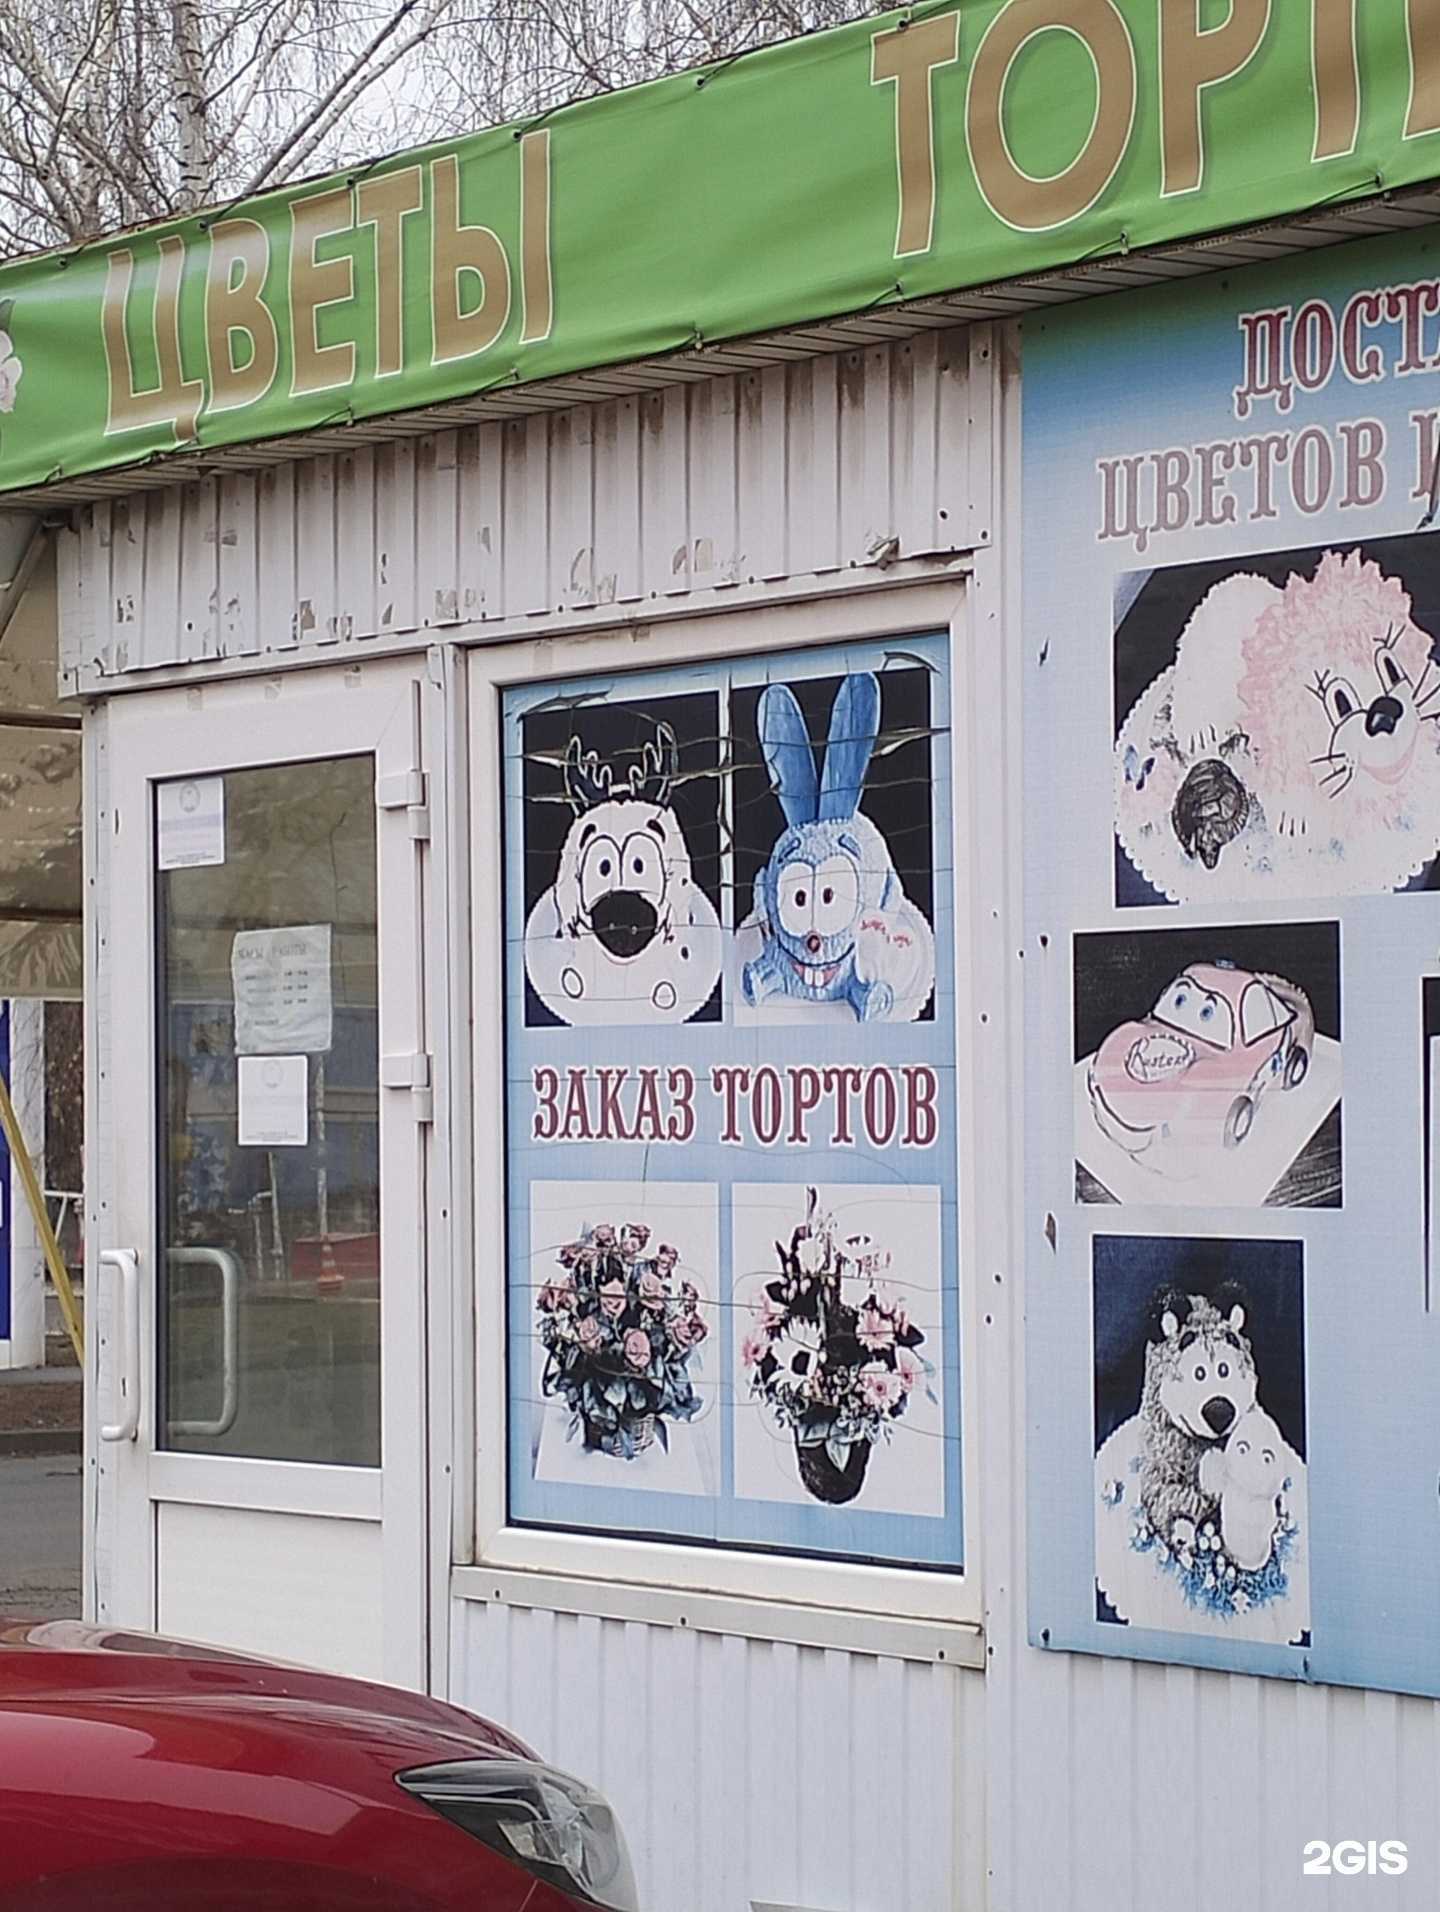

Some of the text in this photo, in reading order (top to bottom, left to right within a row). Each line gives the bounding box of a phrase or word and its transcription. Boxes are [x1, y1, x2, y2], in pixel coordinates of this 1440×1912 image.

[103, 0, 1440, 444] ЦВЕТЫ ТОР
[1236, 280, 1440, 416] ДОСТ
[1098, 418, 1386, 553] ЦВЕТОВ
[531, 1065, 939, 1148] ЗАКАЗ ТОРТОВ
